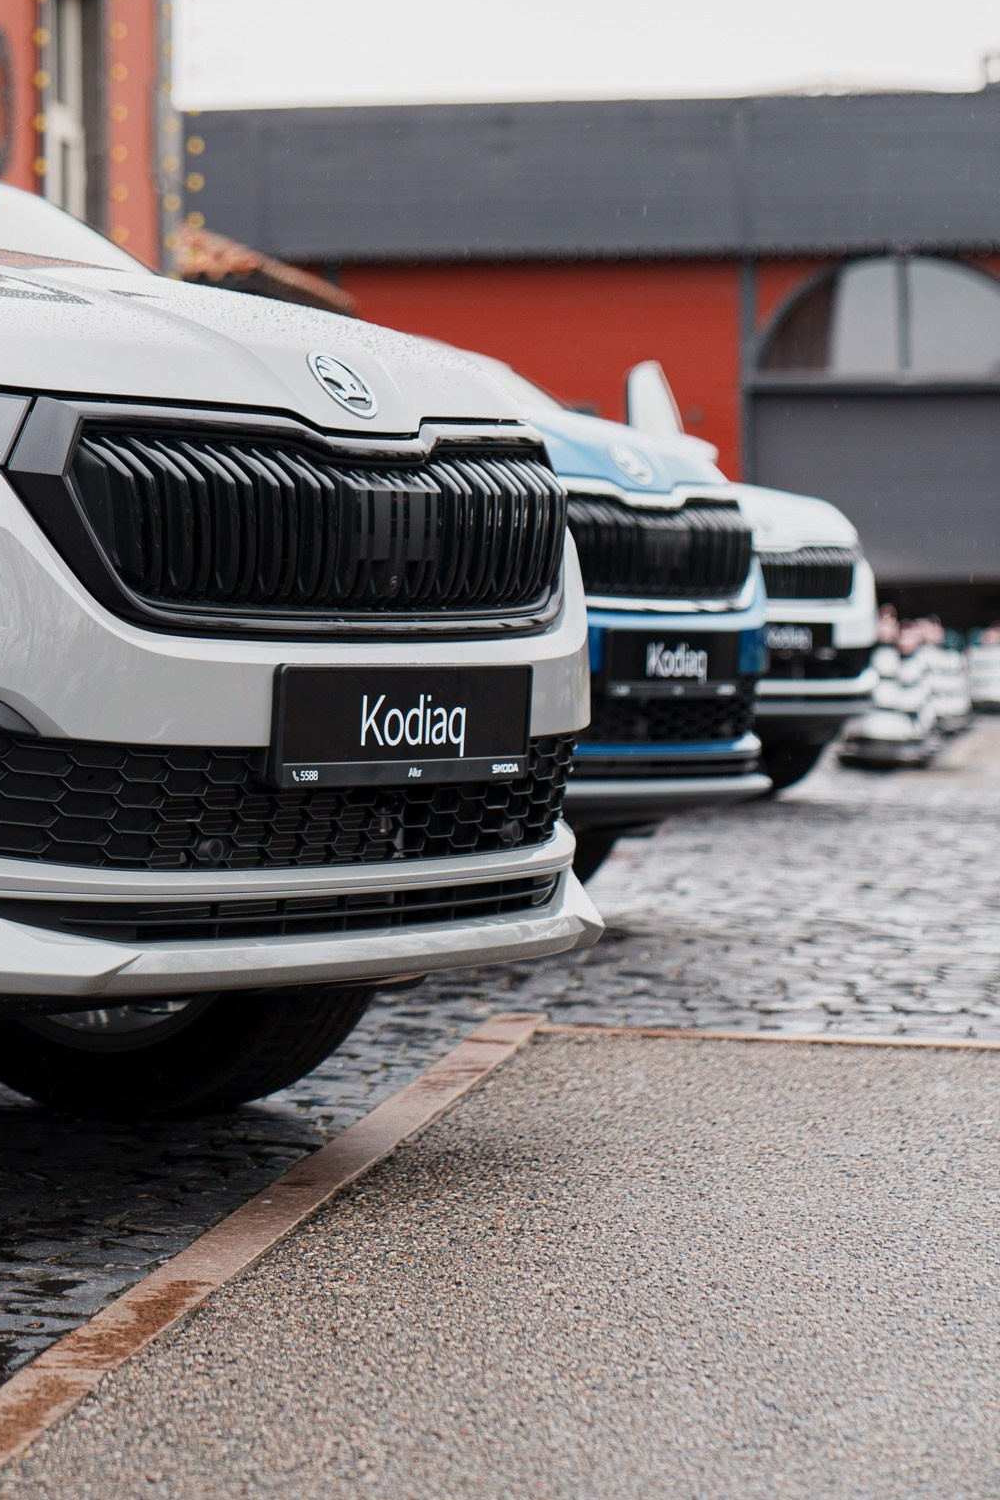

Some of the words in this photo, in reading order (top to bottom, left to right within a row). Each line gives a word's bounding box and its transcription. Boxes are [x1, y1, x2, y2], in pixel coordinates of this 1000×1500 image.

[646, 642, 708, 685] Kodiaq
[360, 694, 466, 757] Kodiaq
[300, 770, 319, 781] 5588
